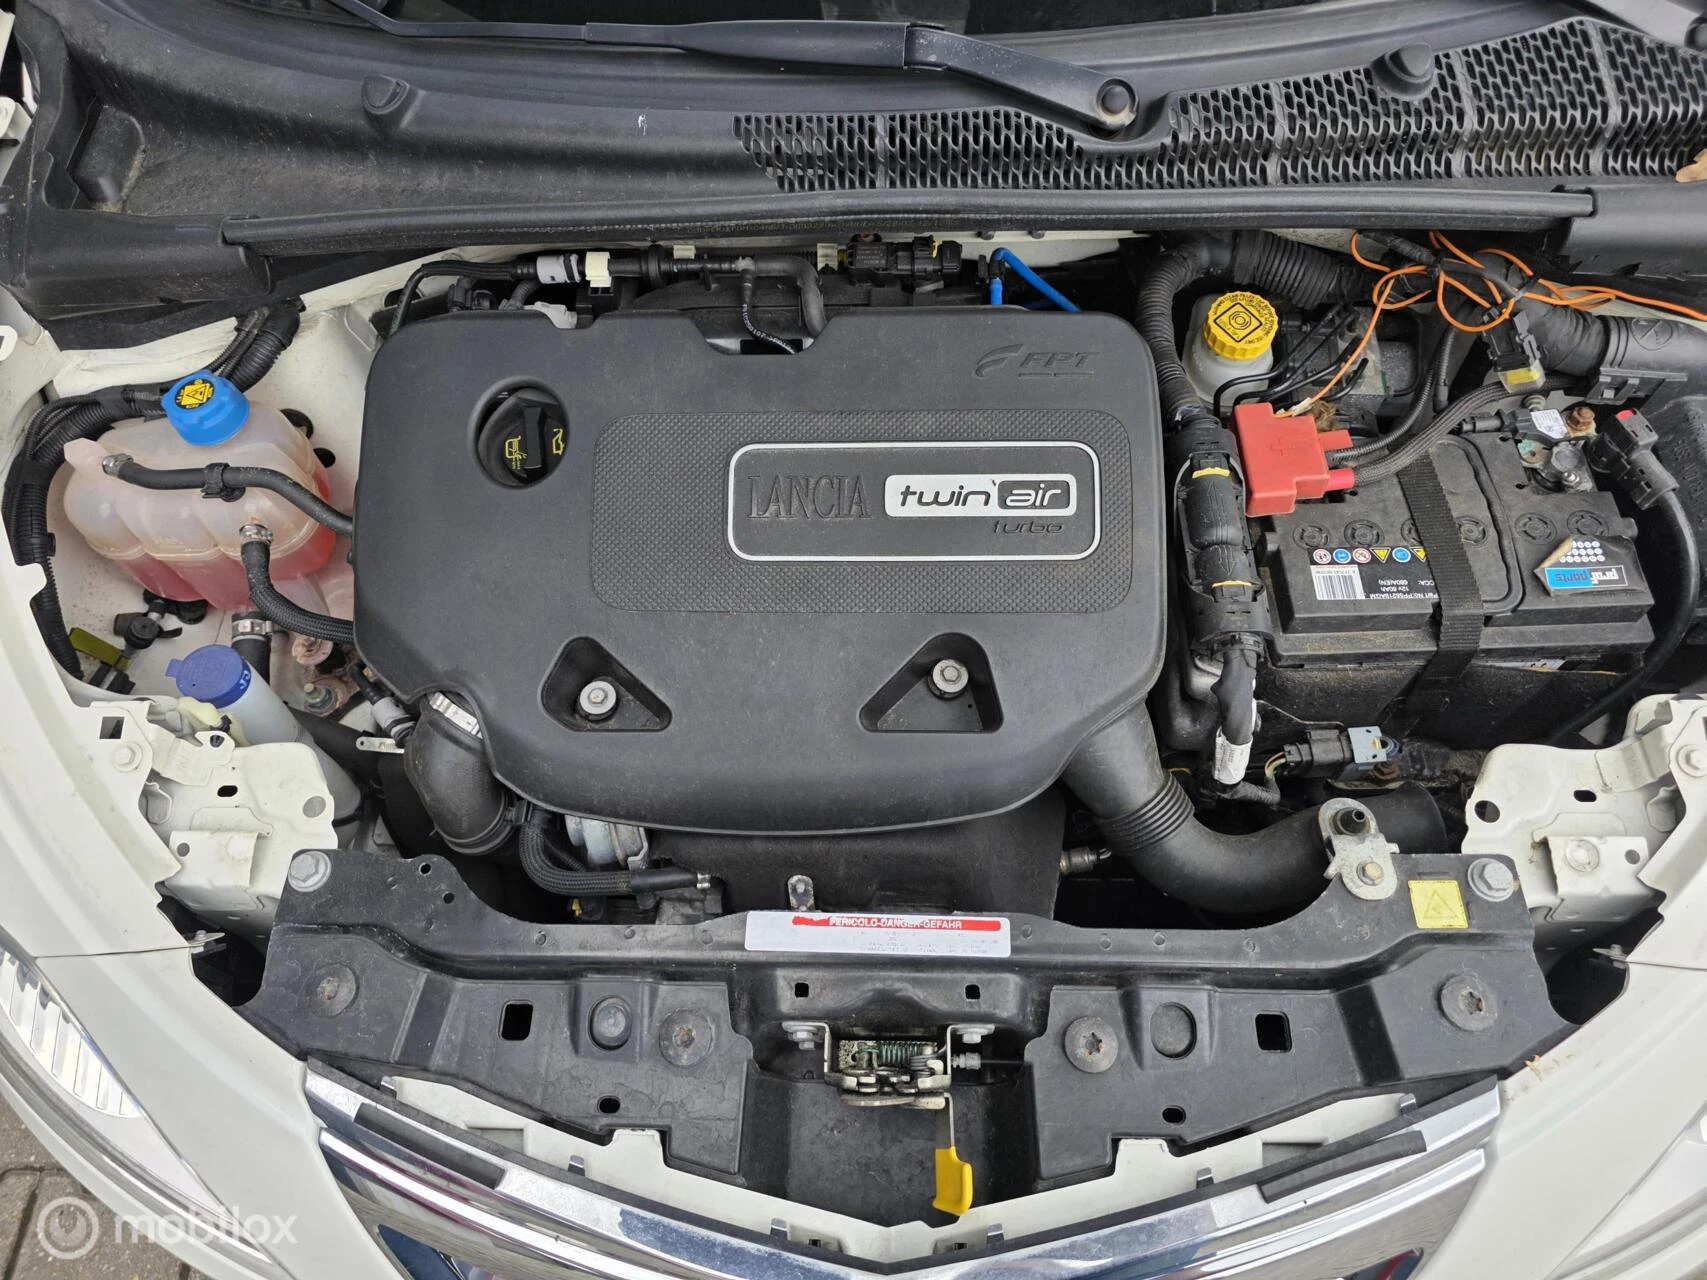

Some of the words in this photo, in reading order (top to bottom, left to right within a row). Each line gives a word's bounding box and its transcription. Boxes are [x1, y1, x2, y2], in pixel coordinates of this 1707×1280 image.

[1019, 351, 1100, 368] FPT
[747, 475, 873, 520] LANCIA
[900, 485, 991, 507] twin
[1006, 483, 1062, 507] air
[994, 519, 1064, 534] turbo
